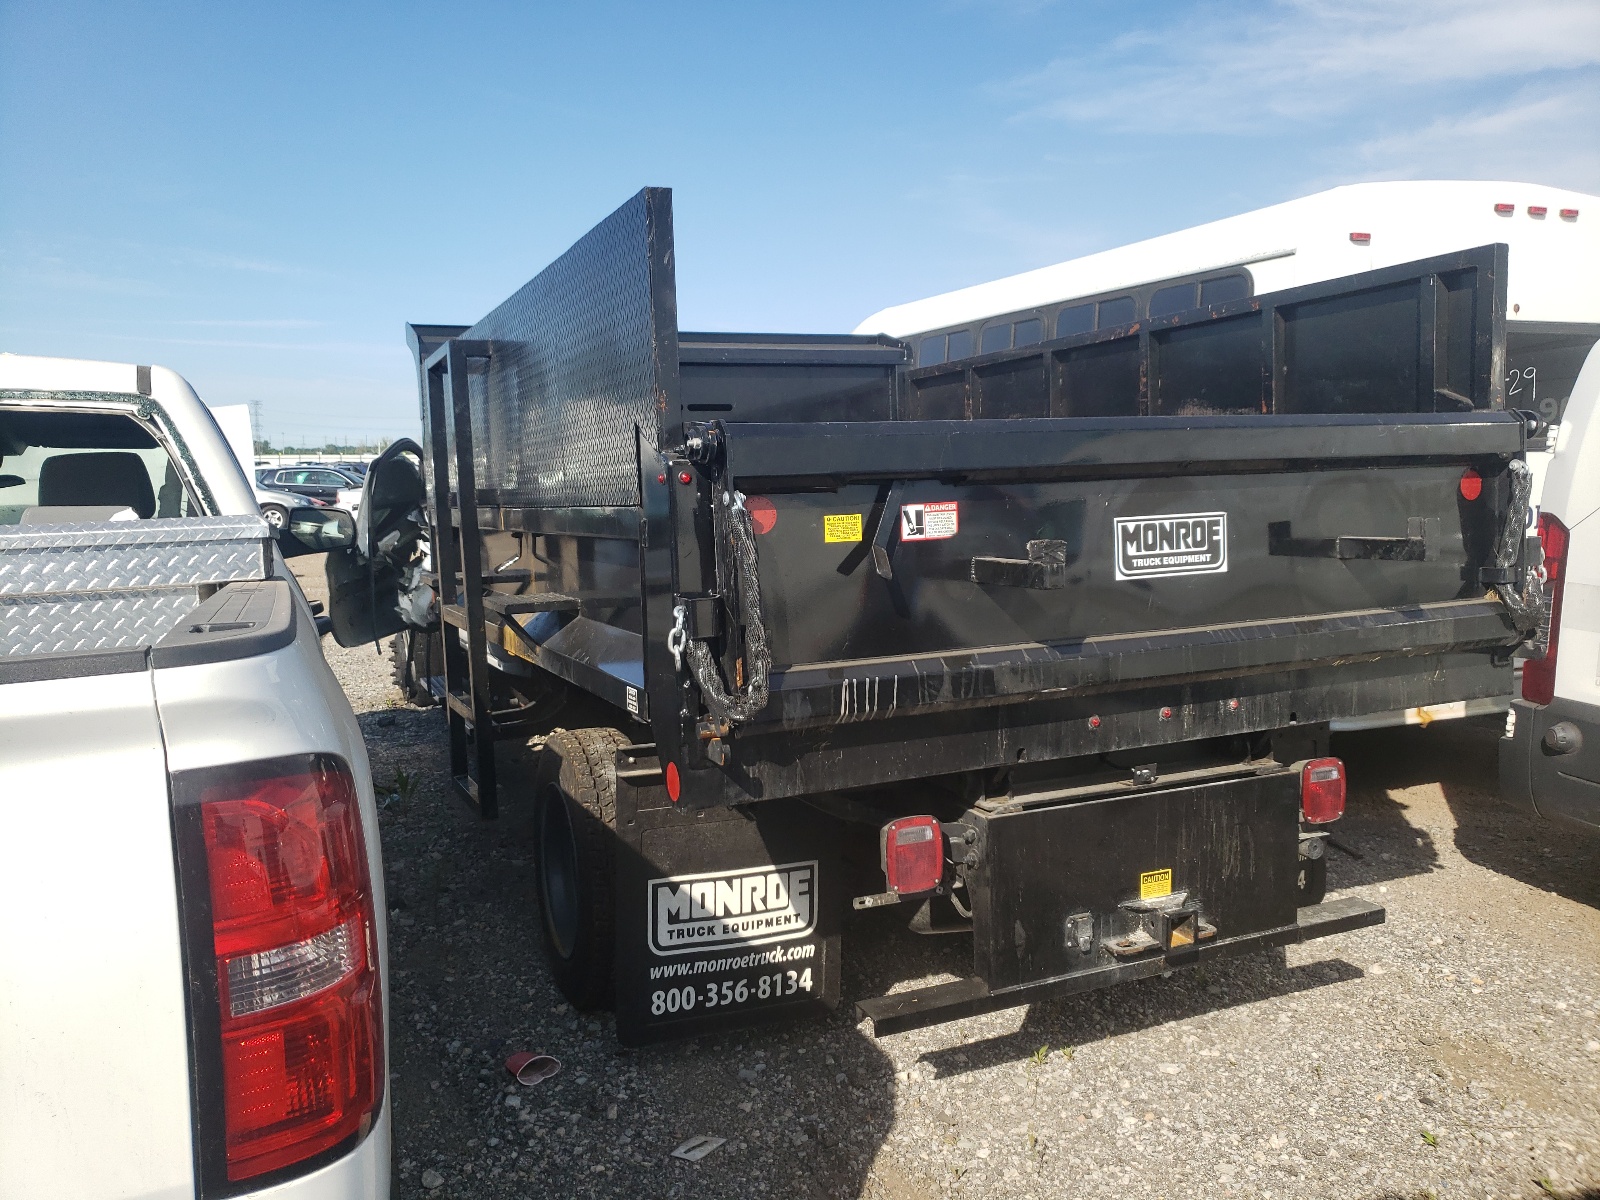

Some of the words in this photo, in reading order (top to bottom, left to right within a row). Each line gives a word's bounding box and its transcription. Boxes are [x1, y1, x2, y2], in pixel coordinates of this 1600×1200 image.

[931, 503, 956, 511] DANGER
[1120, 519, 1221, 553] MONROE
[1132, 557, 1161, 567] TRUCK
[1163, 553, 1212, 565] EQUIPMENT
[1143, 872, 1169, 884] CAUTION
[657, 868, 811, 922] MONROE
[667, 925, 716, 940] TRUCK
[722, 912, 801, 935] EQUIPMENT
[650, 944, 816, 980] www.monroetruck.com
